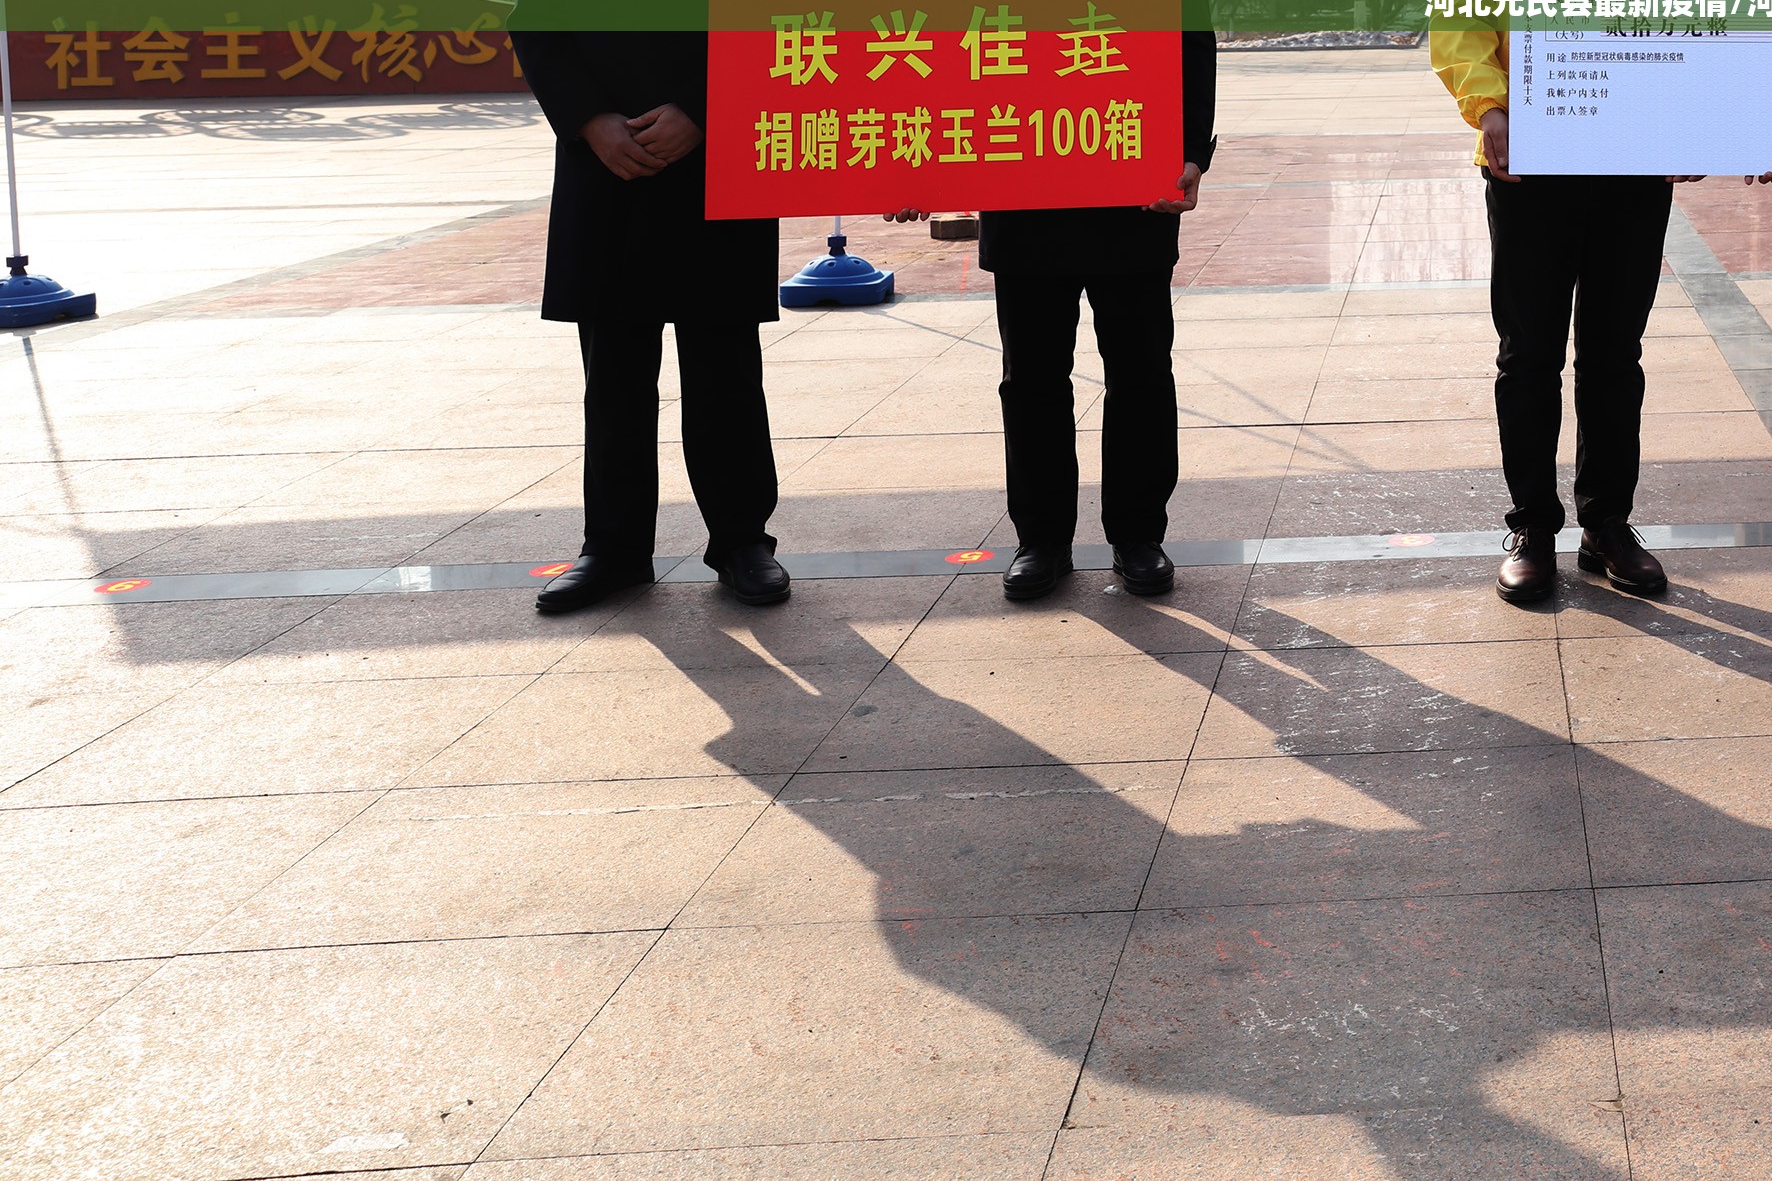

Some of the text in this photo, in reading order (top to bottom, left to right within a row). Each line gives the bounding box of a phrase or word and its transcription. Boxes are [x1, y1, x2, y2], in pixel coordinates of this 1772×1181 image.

[44, 2, 524, 90] 社会主义核心
[769, 1, 1130, 86] 联兴佳垚
[1546, 52, 1566, 63] 用途
[1546, 70, 1609, 80] 上列款项请从
[1546, 105, 1598, 116] 出票人签章
[754, 98, 1144, 172] 捐赠芽球玉兰100箱
